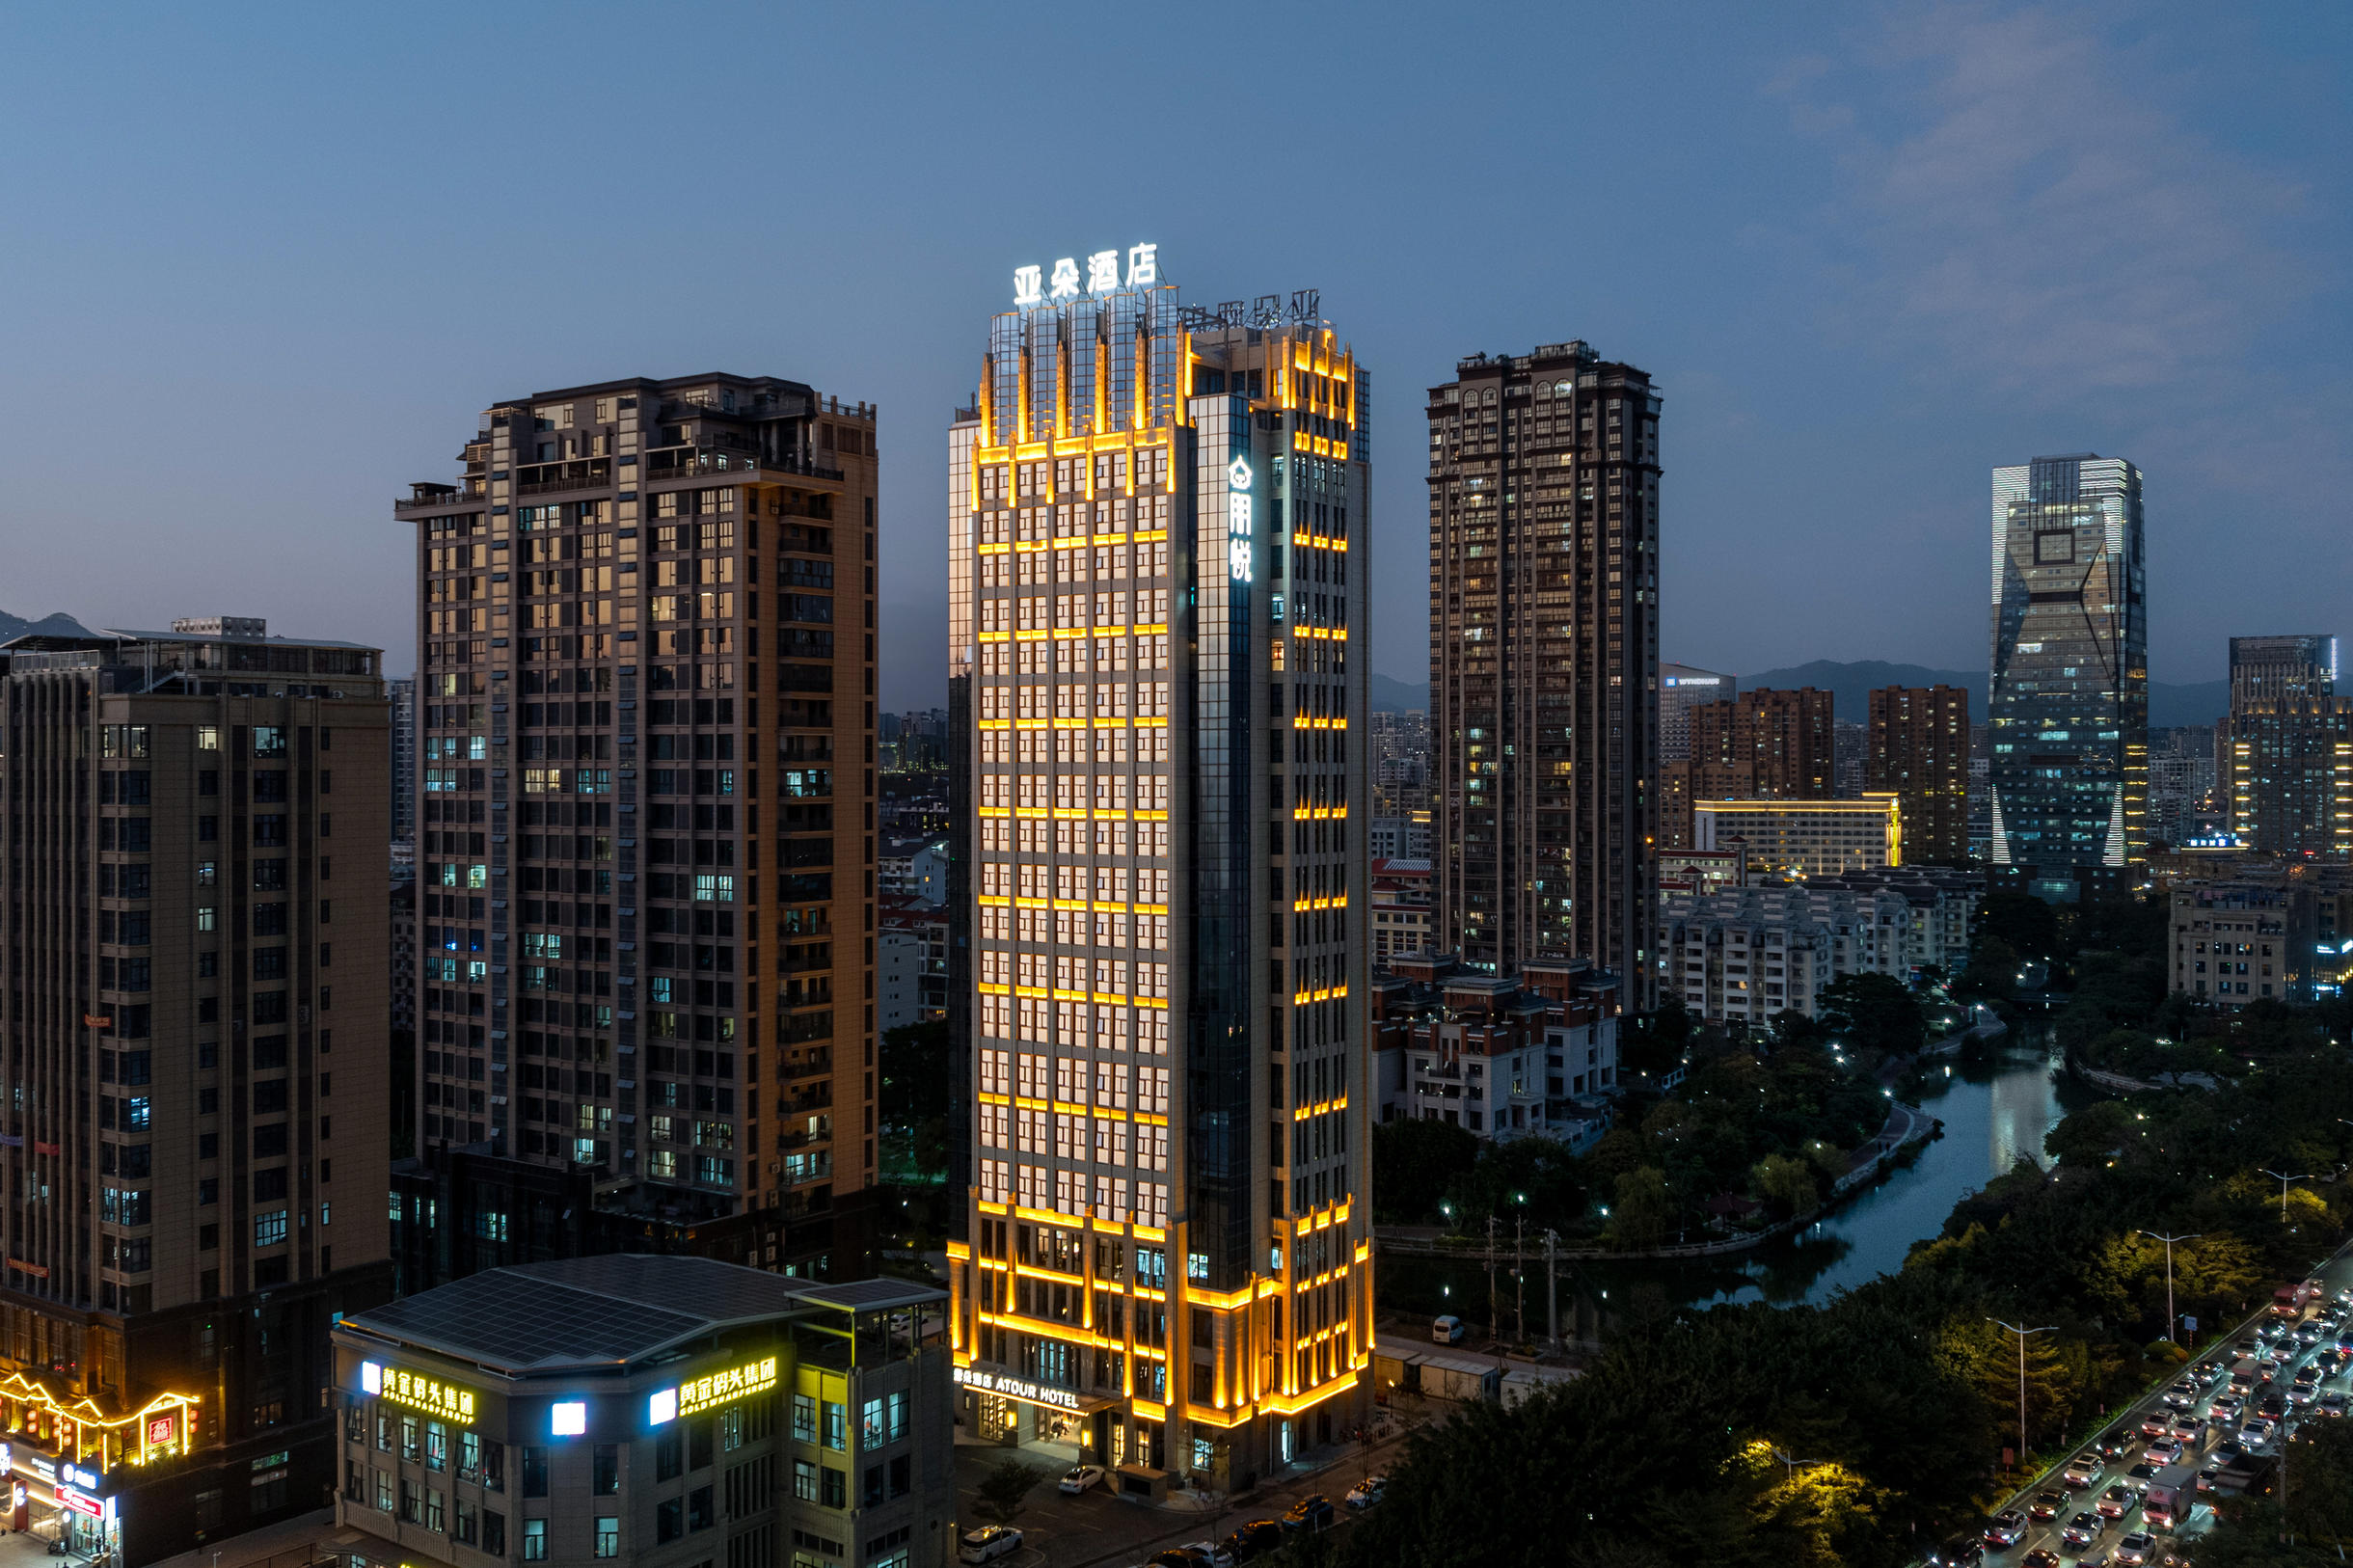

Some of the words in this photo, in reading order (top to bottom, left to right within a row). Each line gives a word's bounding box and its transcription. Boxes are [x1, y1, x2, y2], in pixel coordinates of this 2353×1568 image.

[1014, 242, 1157, 305] 亚朵酒店
[383, 1367, 473, 1416] 黄金码头集团
[679, 1356, 776, 1408] 黄金码头集团
[995, 1377, 1037, 1399] ATOUR
[1040, 1387, 1079, 1409] HOTEL
